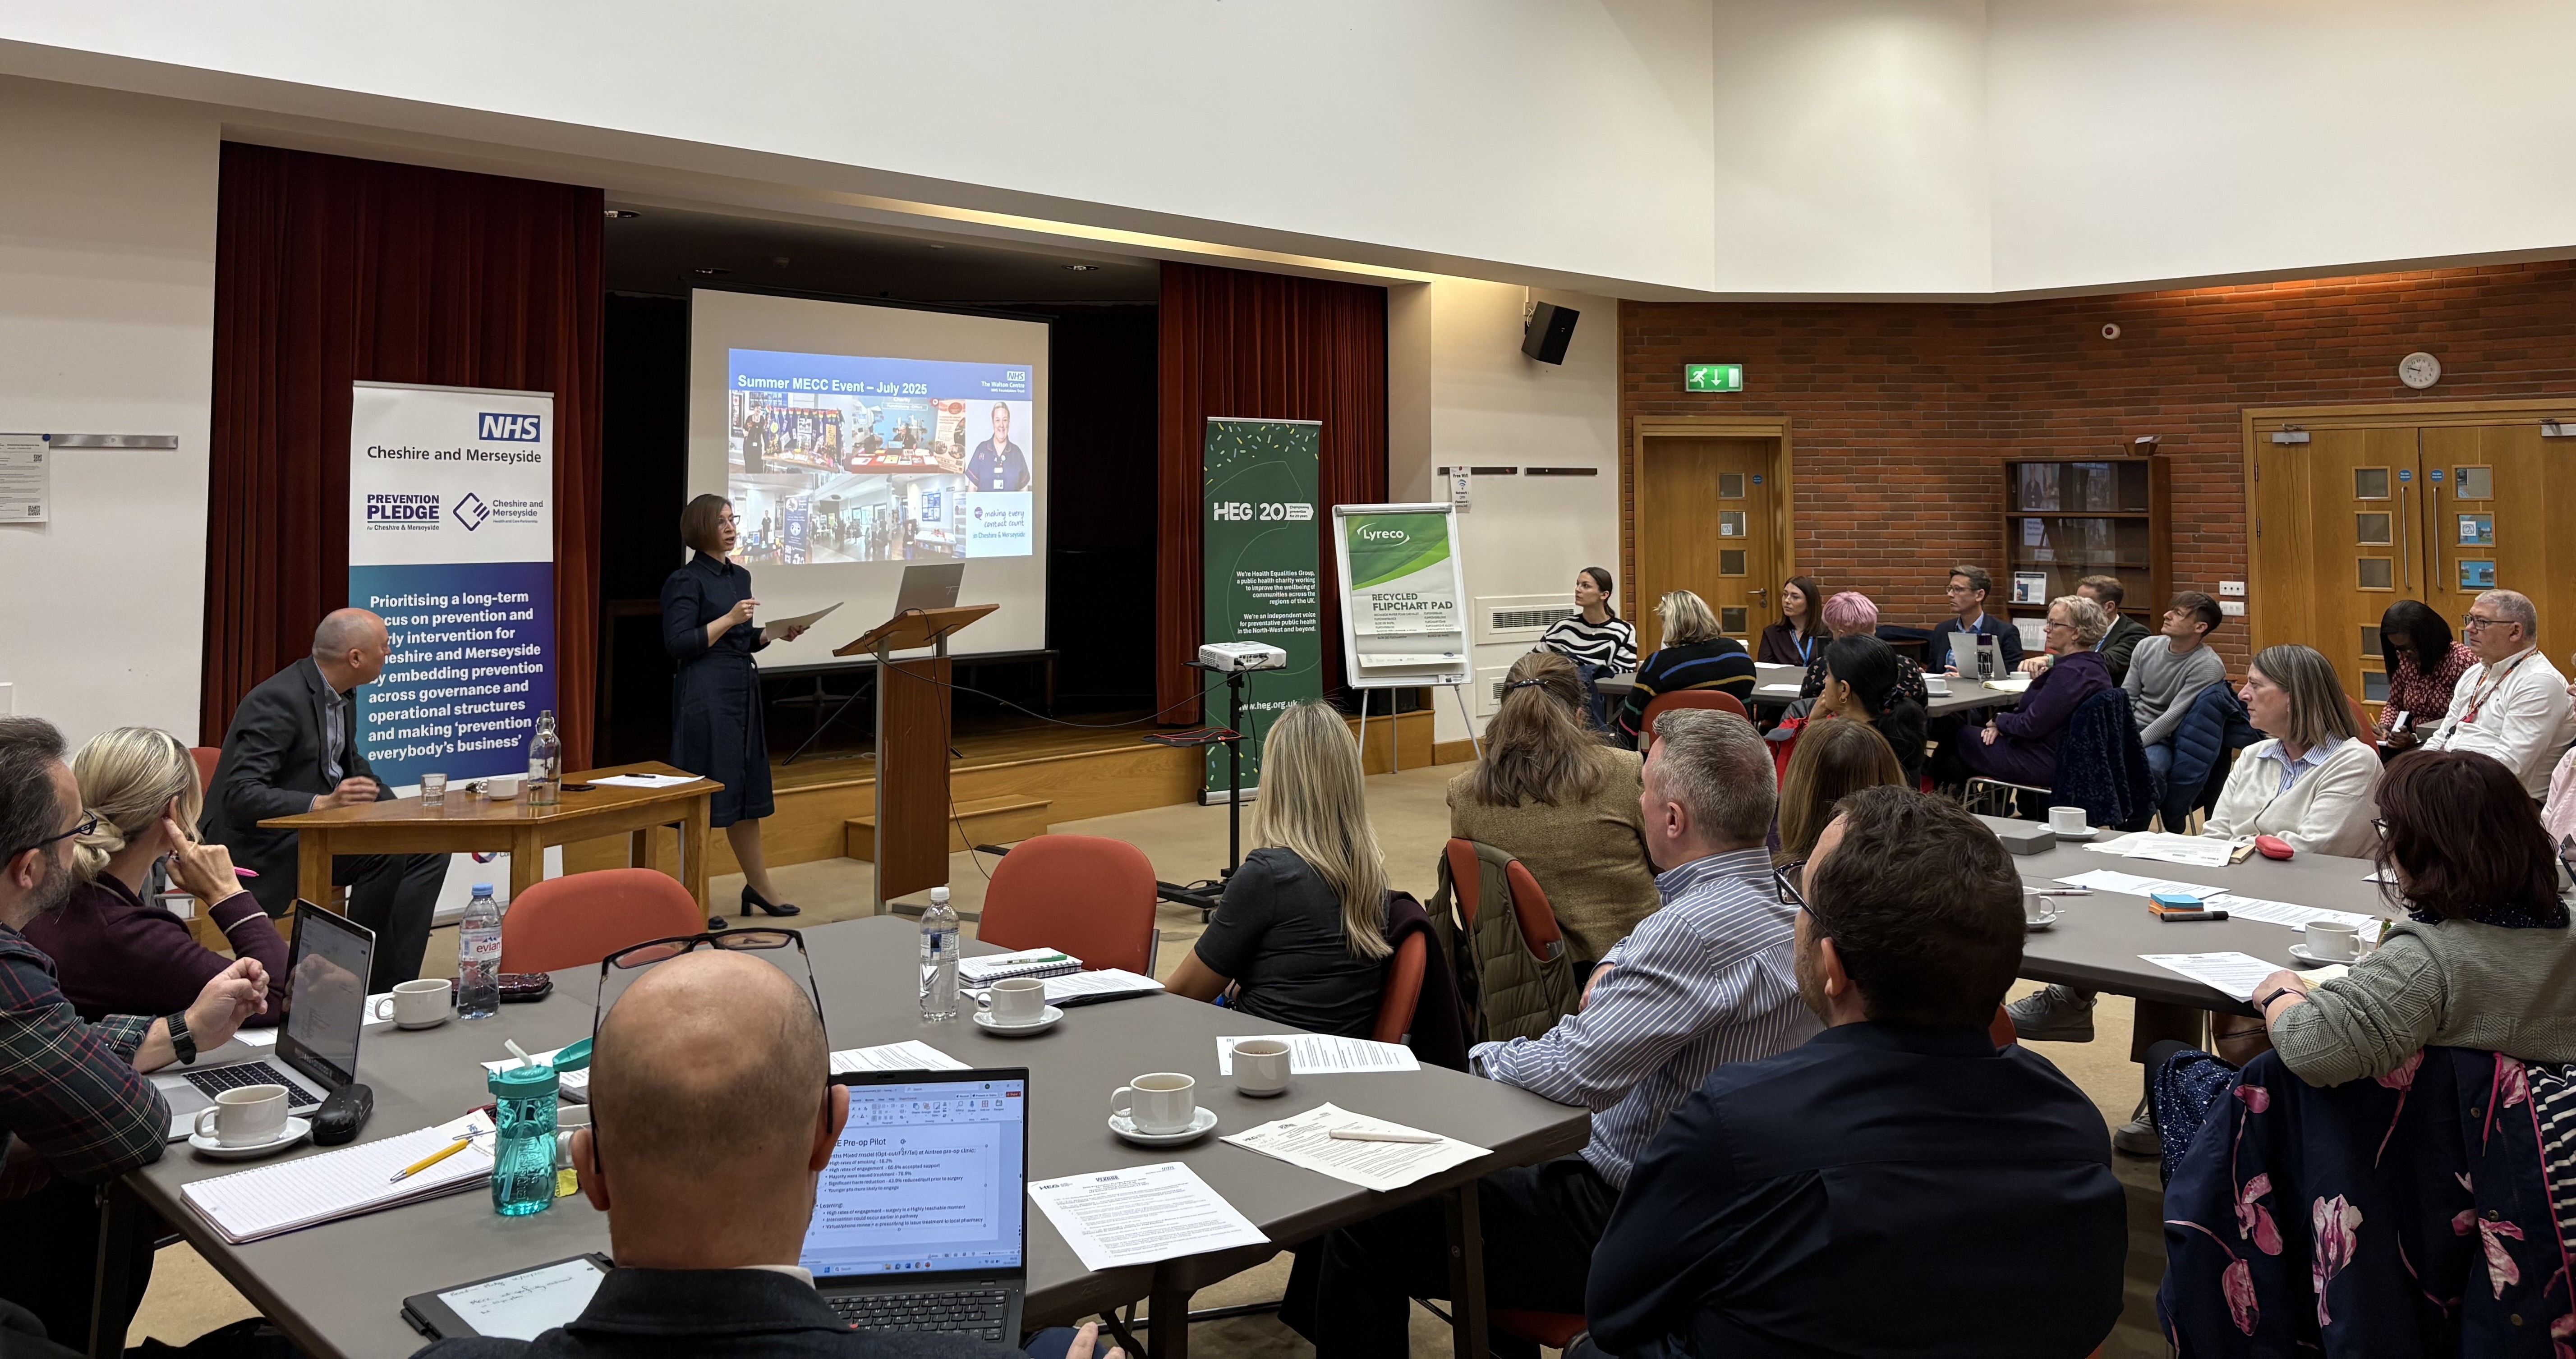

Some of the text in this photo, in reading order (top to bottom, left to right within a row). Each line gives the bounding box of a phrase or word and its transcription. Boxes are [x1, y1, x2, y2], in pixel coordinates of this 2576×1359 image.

[738, 375, 790, 389] Summer
[793, 377, 828, 391] MECC
[832, 379, 864, 392] Event
[877, 381, 899, 395] July
[902, 383, 927, 395] 2025
[481, 415, 538, 440] NHS
[367, 445, 541, 464] Cheshire and Merseyside
[367, 494, 439, 504] PREVENTION
[367, 505, 439, 519] PLEDGE
[493, 509, 538, 517] Merseyside
[985, 510, 1006, 519] making
[1008, 511, 1024, 519] every
[1214, 501, 1284, 520] HEG 20
[1364, 529, 1404, 541] Lyreco
[370, 592, 529, 608] Prioritising a long-term
[1372, 593, 1418, 601] RECYCLED
[1373, 601, 1453, 611] FLIPCHART PAD
[382, 608, 534, 627] cus on prevention and
[387, 627, 515, 648] rly intervention for
[384, 644, 541, 664] eshire and Merseyside
[389, 666, 469, 684] embedding
[472, 662, 543, 680] prevention
[368, 680, 529, 703] across governance and
[368, 699, 525, 725] operational structures
[1239, 700, 1297, 711] ww.heg.org.uk
[368, 728, 395, 742] and
[398, 722, 451, 739] making
[476, 941, 501, 953] evian
